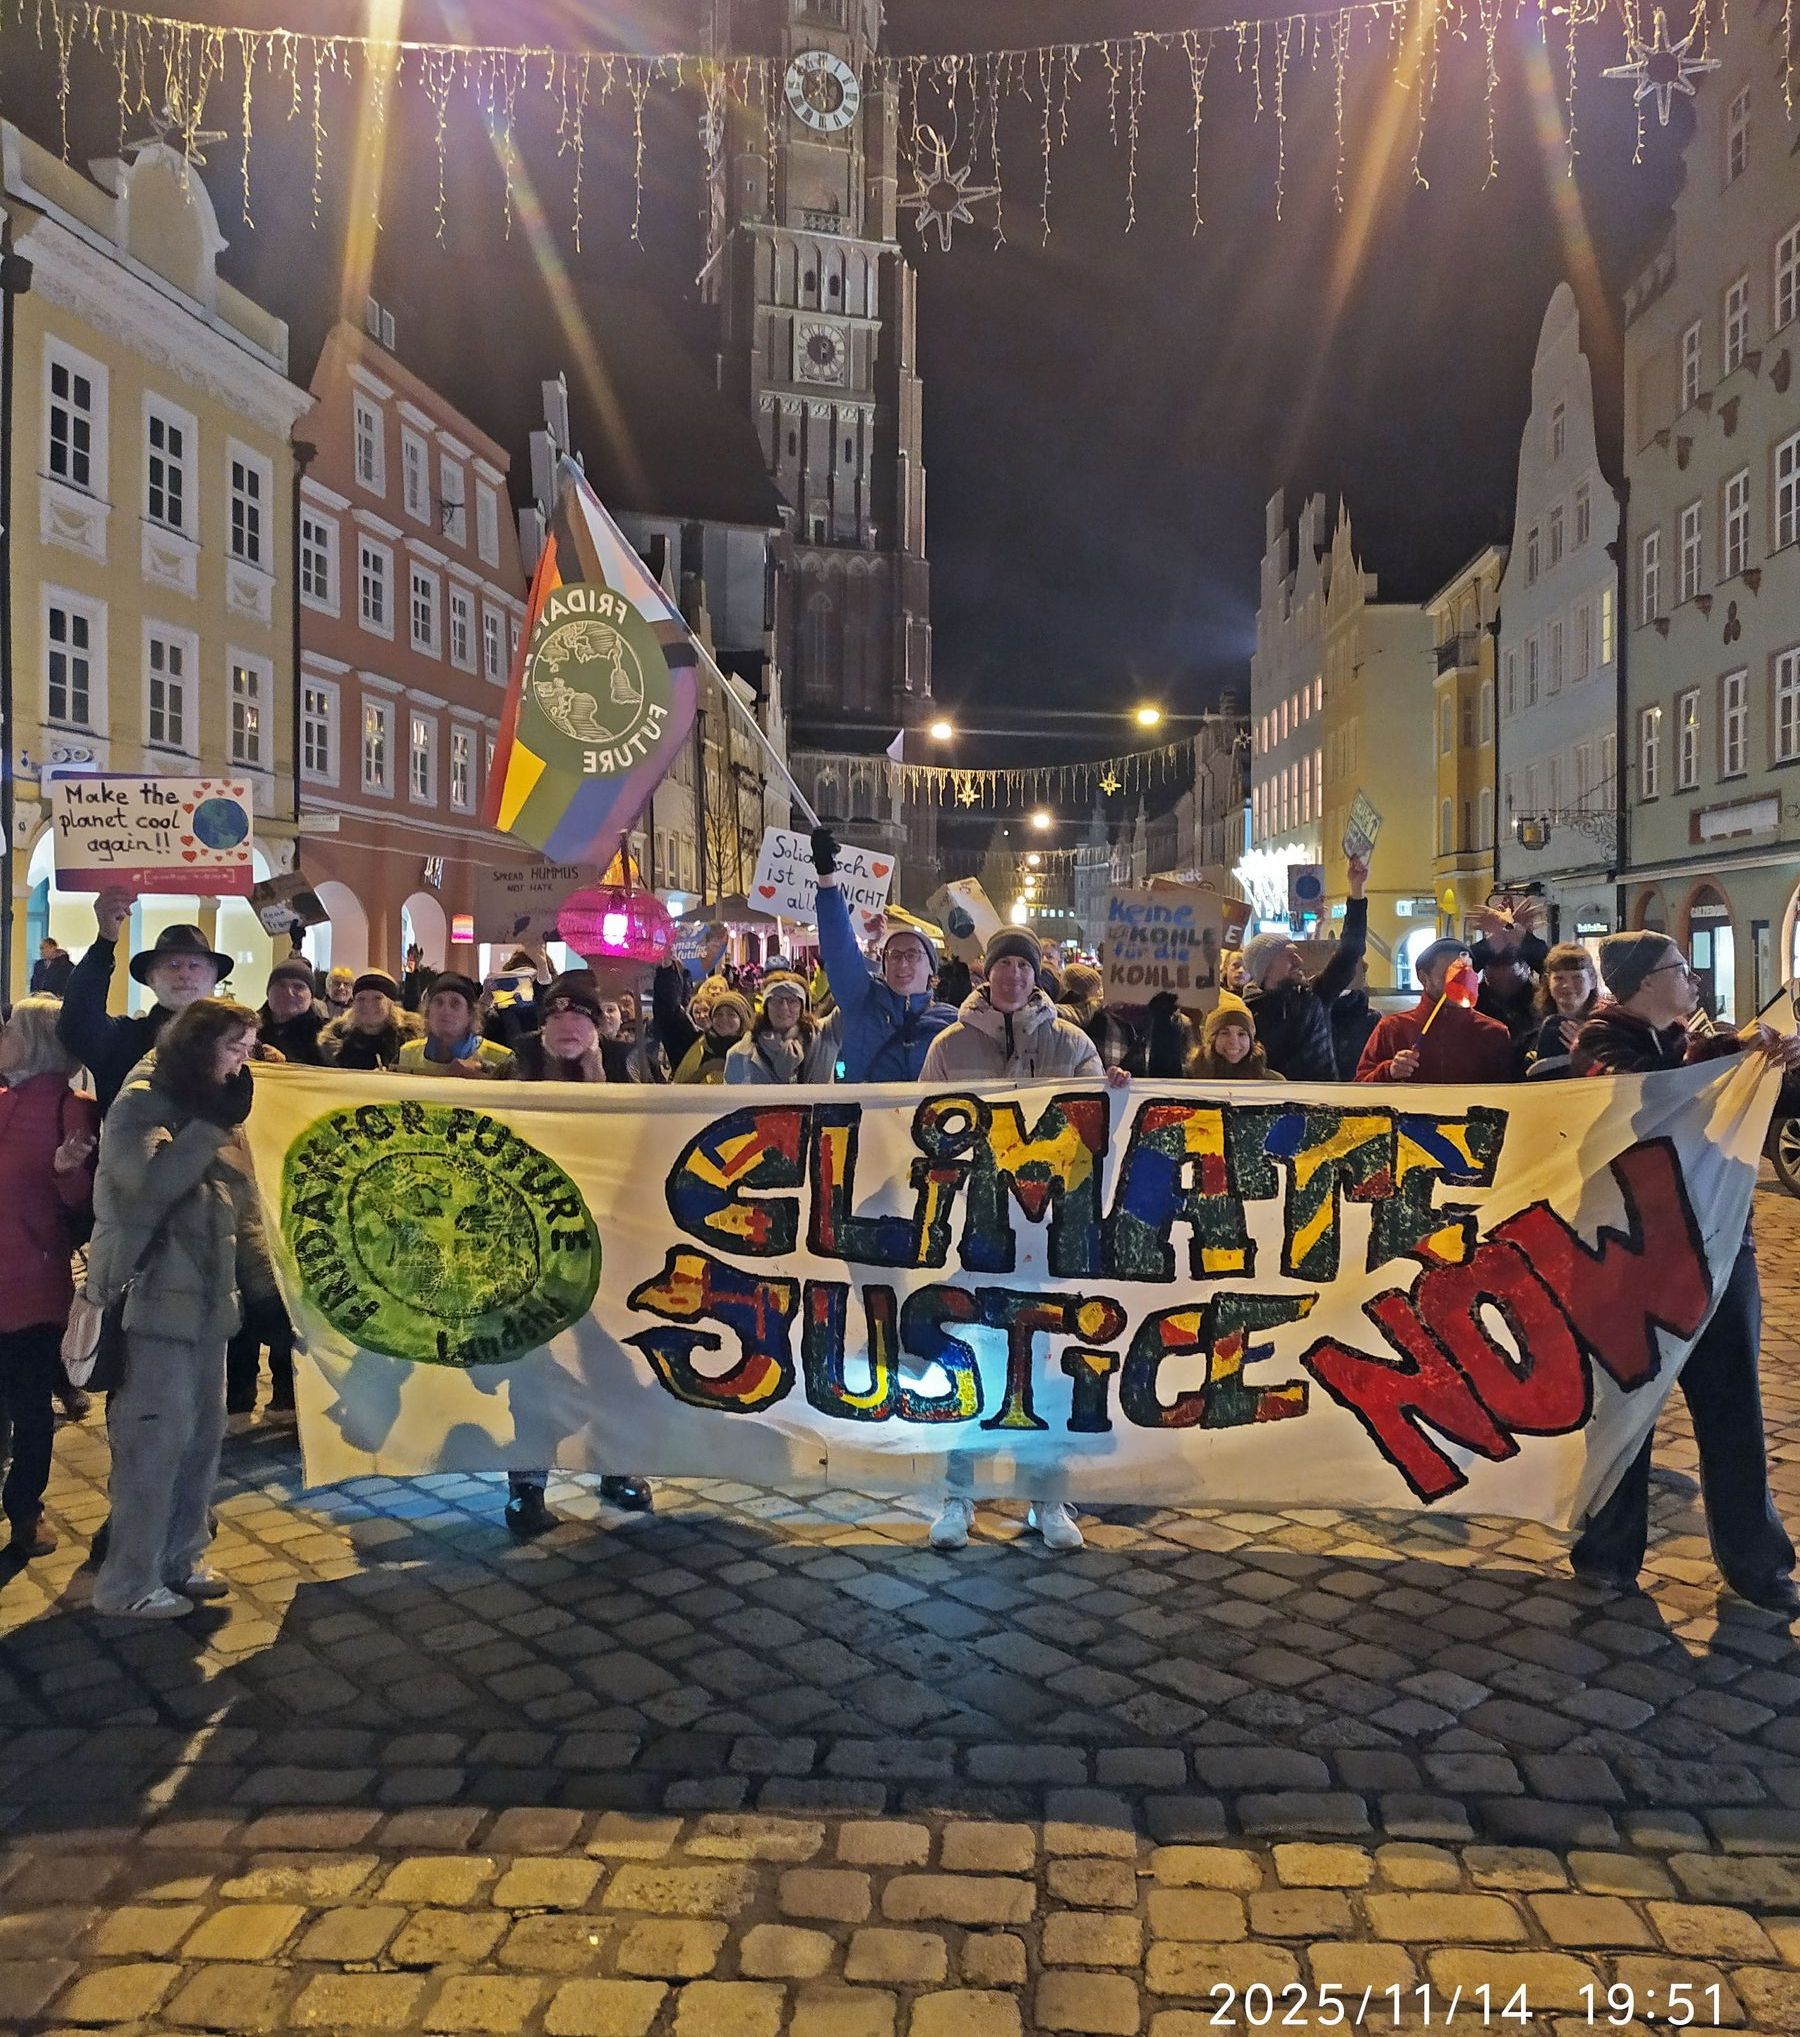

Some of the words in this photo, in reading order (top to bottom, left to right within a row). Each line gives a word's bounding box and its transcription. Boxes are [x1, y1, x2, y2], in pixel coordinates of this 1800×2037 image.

[64, 782, 130, 806] Make
[139, 782, 180, 806] the
[58, 807, 128, 838] planet
[135, 809, 181, 830] cool
[86, 832, 171, 862] again!!
[530, 866, 579, 881] HUMMUS
[766, 862, 796, 886] ist
[839, 882, 885, 909] NICHT
[1108, 896, 1195, 929] Keine
[1128, 925, 1214, 946] KOHLE
[1154, 941, 1190, 962] die
[1110, 963, 1191, 989] KOHLE
[446, 1107, 592, 1252] FUTURE
[1300, 1136, 1713, 1505] NOW
